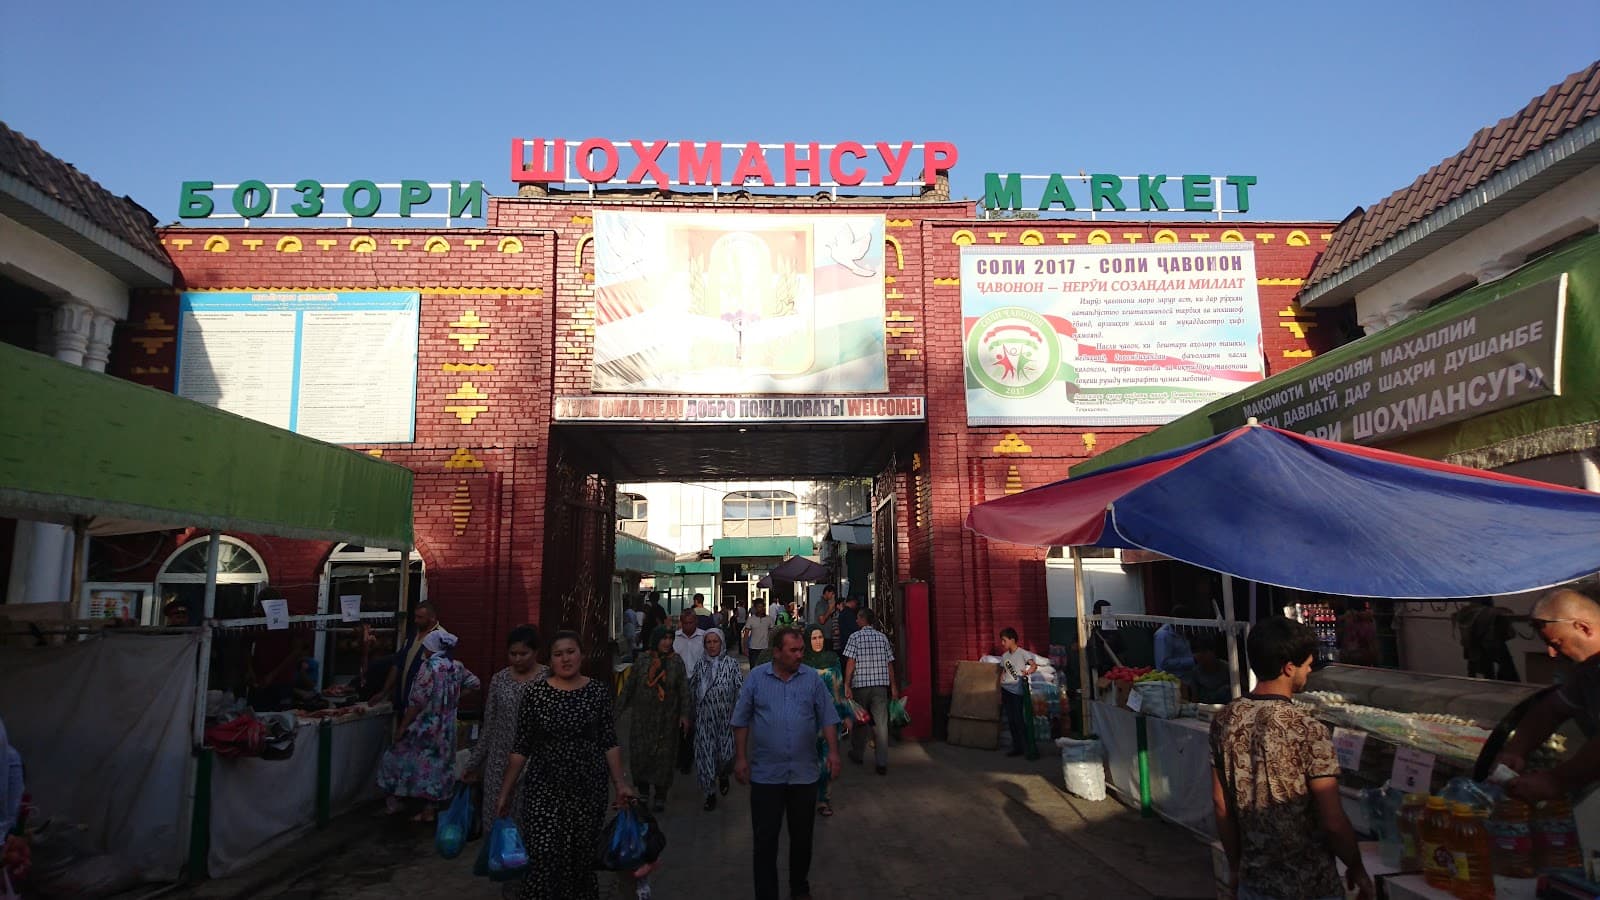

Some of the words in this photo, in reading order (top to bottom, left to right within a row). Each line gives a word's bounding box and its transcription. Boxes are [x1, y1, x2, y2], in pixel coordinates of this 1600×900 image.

[511, 138, 959, 190] ШОҲМАНСУР
[178, 179, 482, 218] БОЗОРИ
[984, 173, 1257, 213] MARKET
[976, 259, 1025, 275] СОЛИ
[1034, 259, 1076, 275] 2017
[1099, 257, 1148, 274] СОЛИ
[1157, 255, 1242, 275] ҶАВОНОН
[976, 281, 1044, 295] ҶАВОНОН
[1111, 279, 1185, 294] СОЗАНДАИ
[1188, 278, 1246, 291] МИЛЛАТ
[1344, 382, 1371, 408] ДАР
[1444, 320, 1544, 375] ДУШАНБЕ
[685, 399, 736, 420] ДОБРО
[847, 398, 921, 416] WELCOME!
